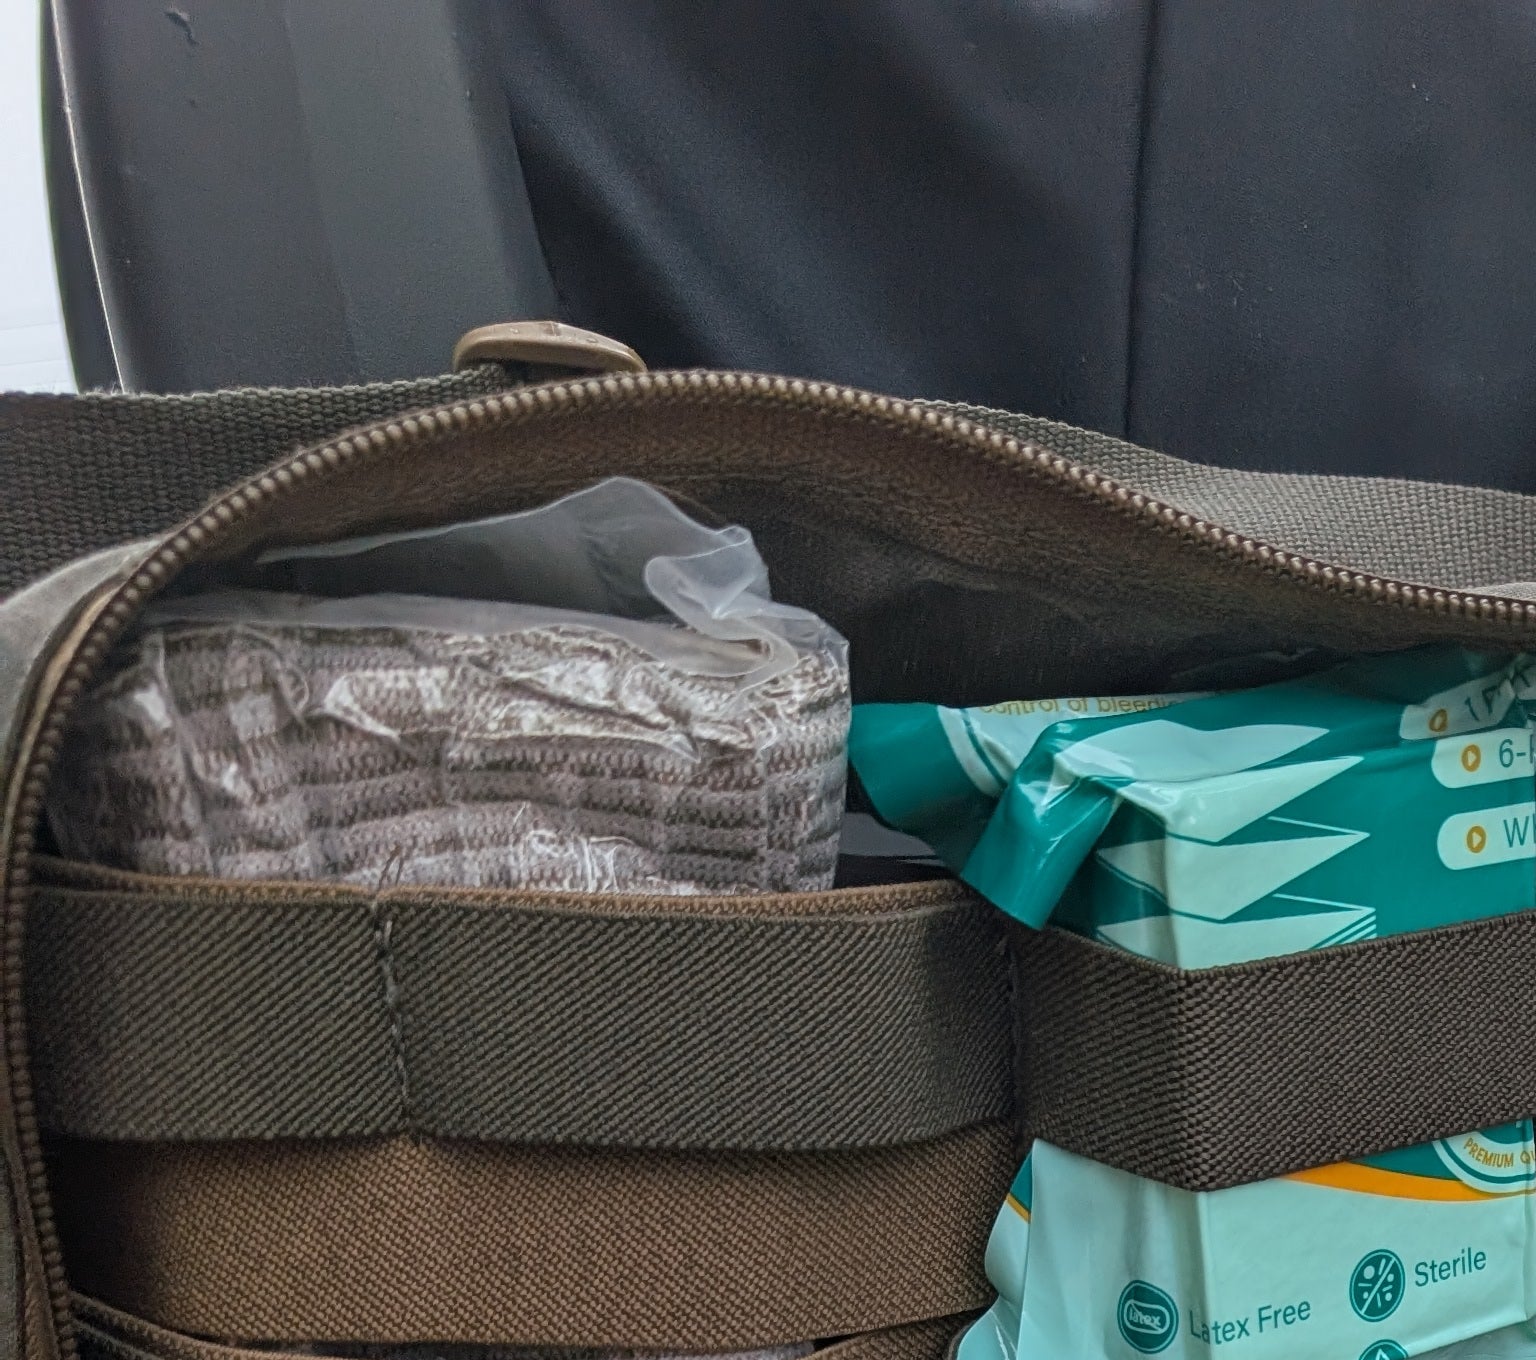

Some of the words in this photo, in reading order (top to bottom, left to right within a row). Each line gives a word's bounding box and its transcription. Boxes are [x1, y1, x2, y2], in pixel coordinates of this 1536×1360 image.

[1464, 1137, 1514, 1168] PREMIUM
[1414, 1246, 1487, 1287] Sterile
[1189, 1311, 1250, 1346] Latex
[1258, 1300, 1311, 1333] Free
